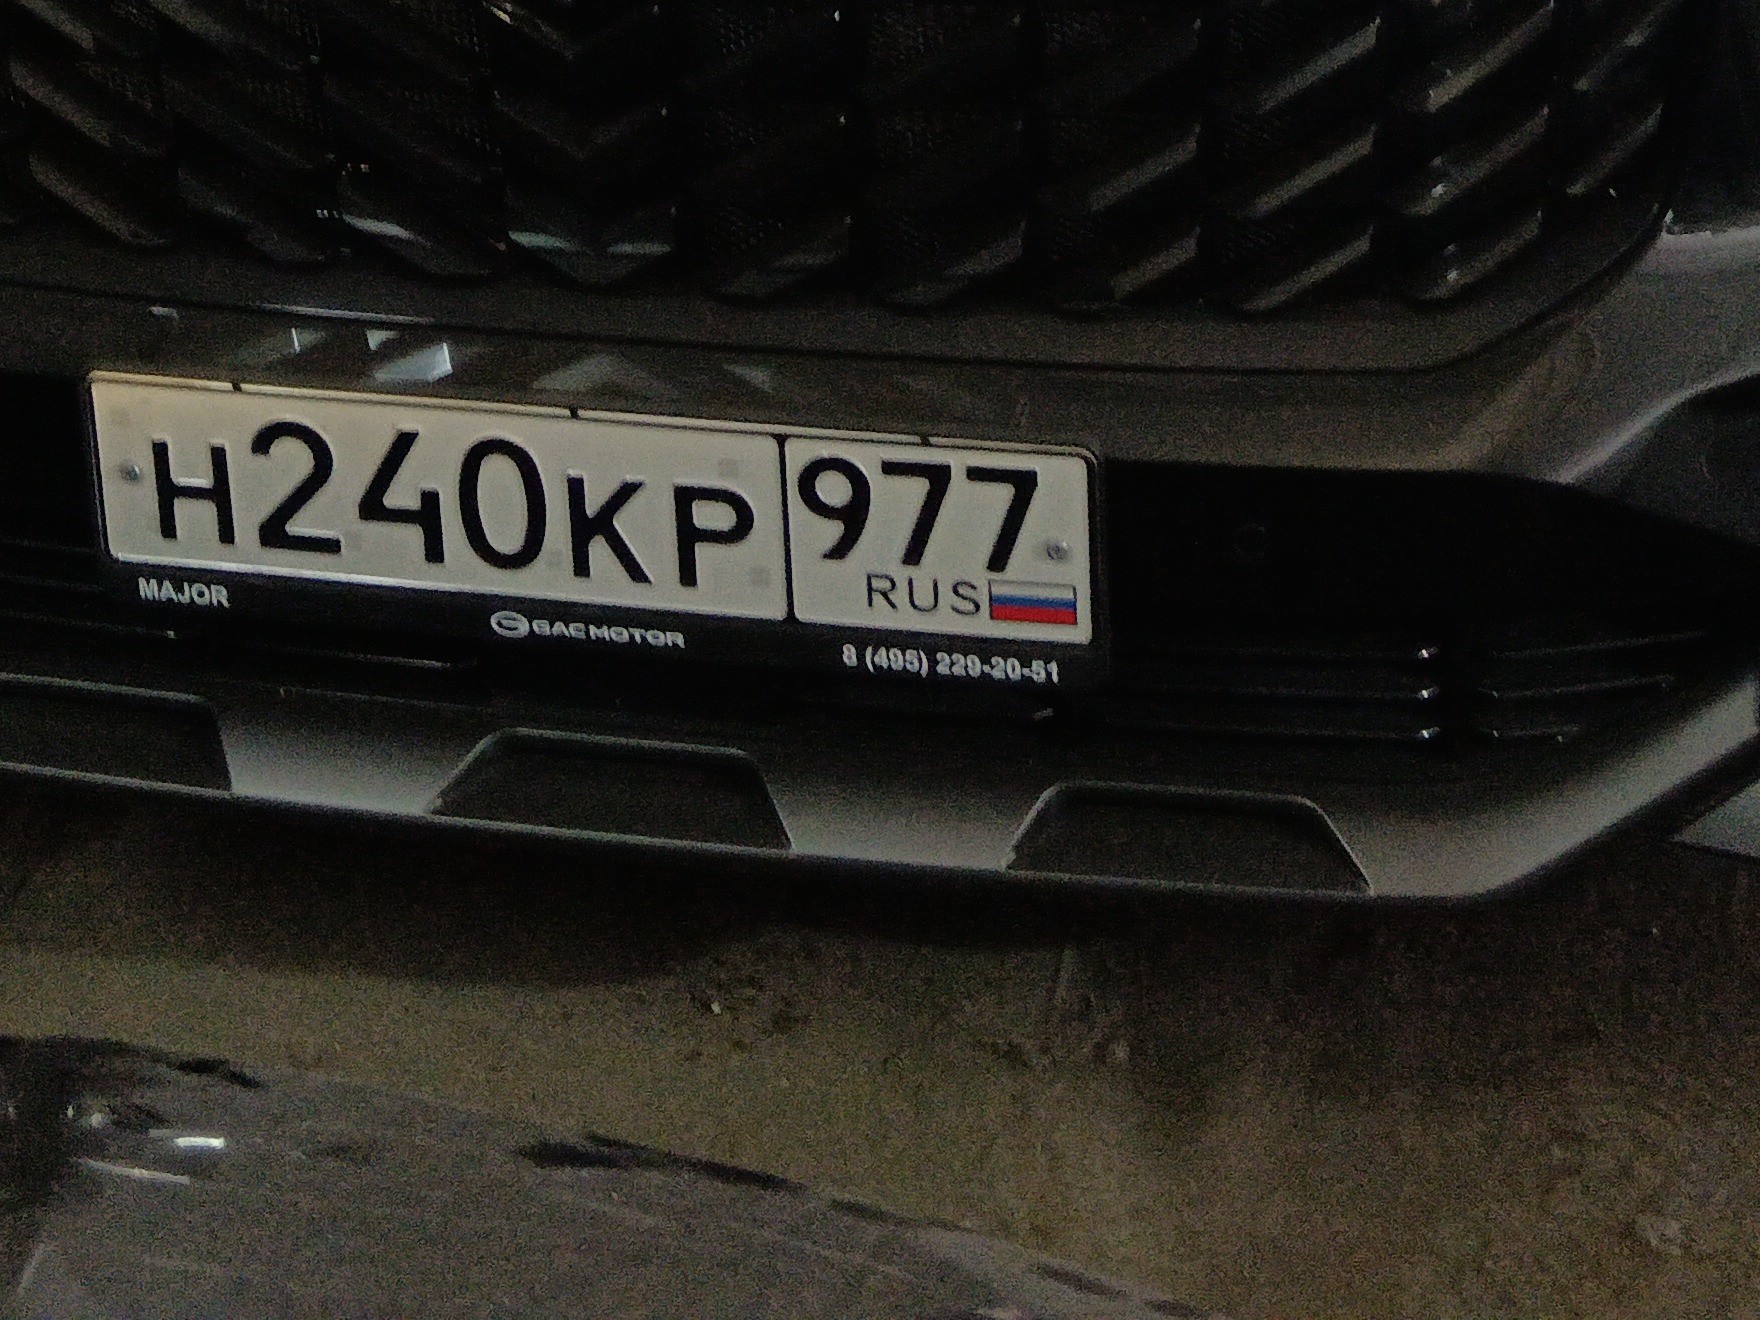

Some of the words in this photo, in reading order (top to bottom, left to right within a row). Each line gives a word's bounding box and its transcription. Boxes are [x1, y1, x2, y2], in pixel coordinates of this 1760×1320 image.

[151, 420, 755, 588] Н240КР
[797, 456, 1039, 573] 977
[138, 576, 231, 609] MAJOR
[866, 571, 981, 615] RUS
[842, 643, 858, 668] 8
[865, 645, 929, 679] (495)
